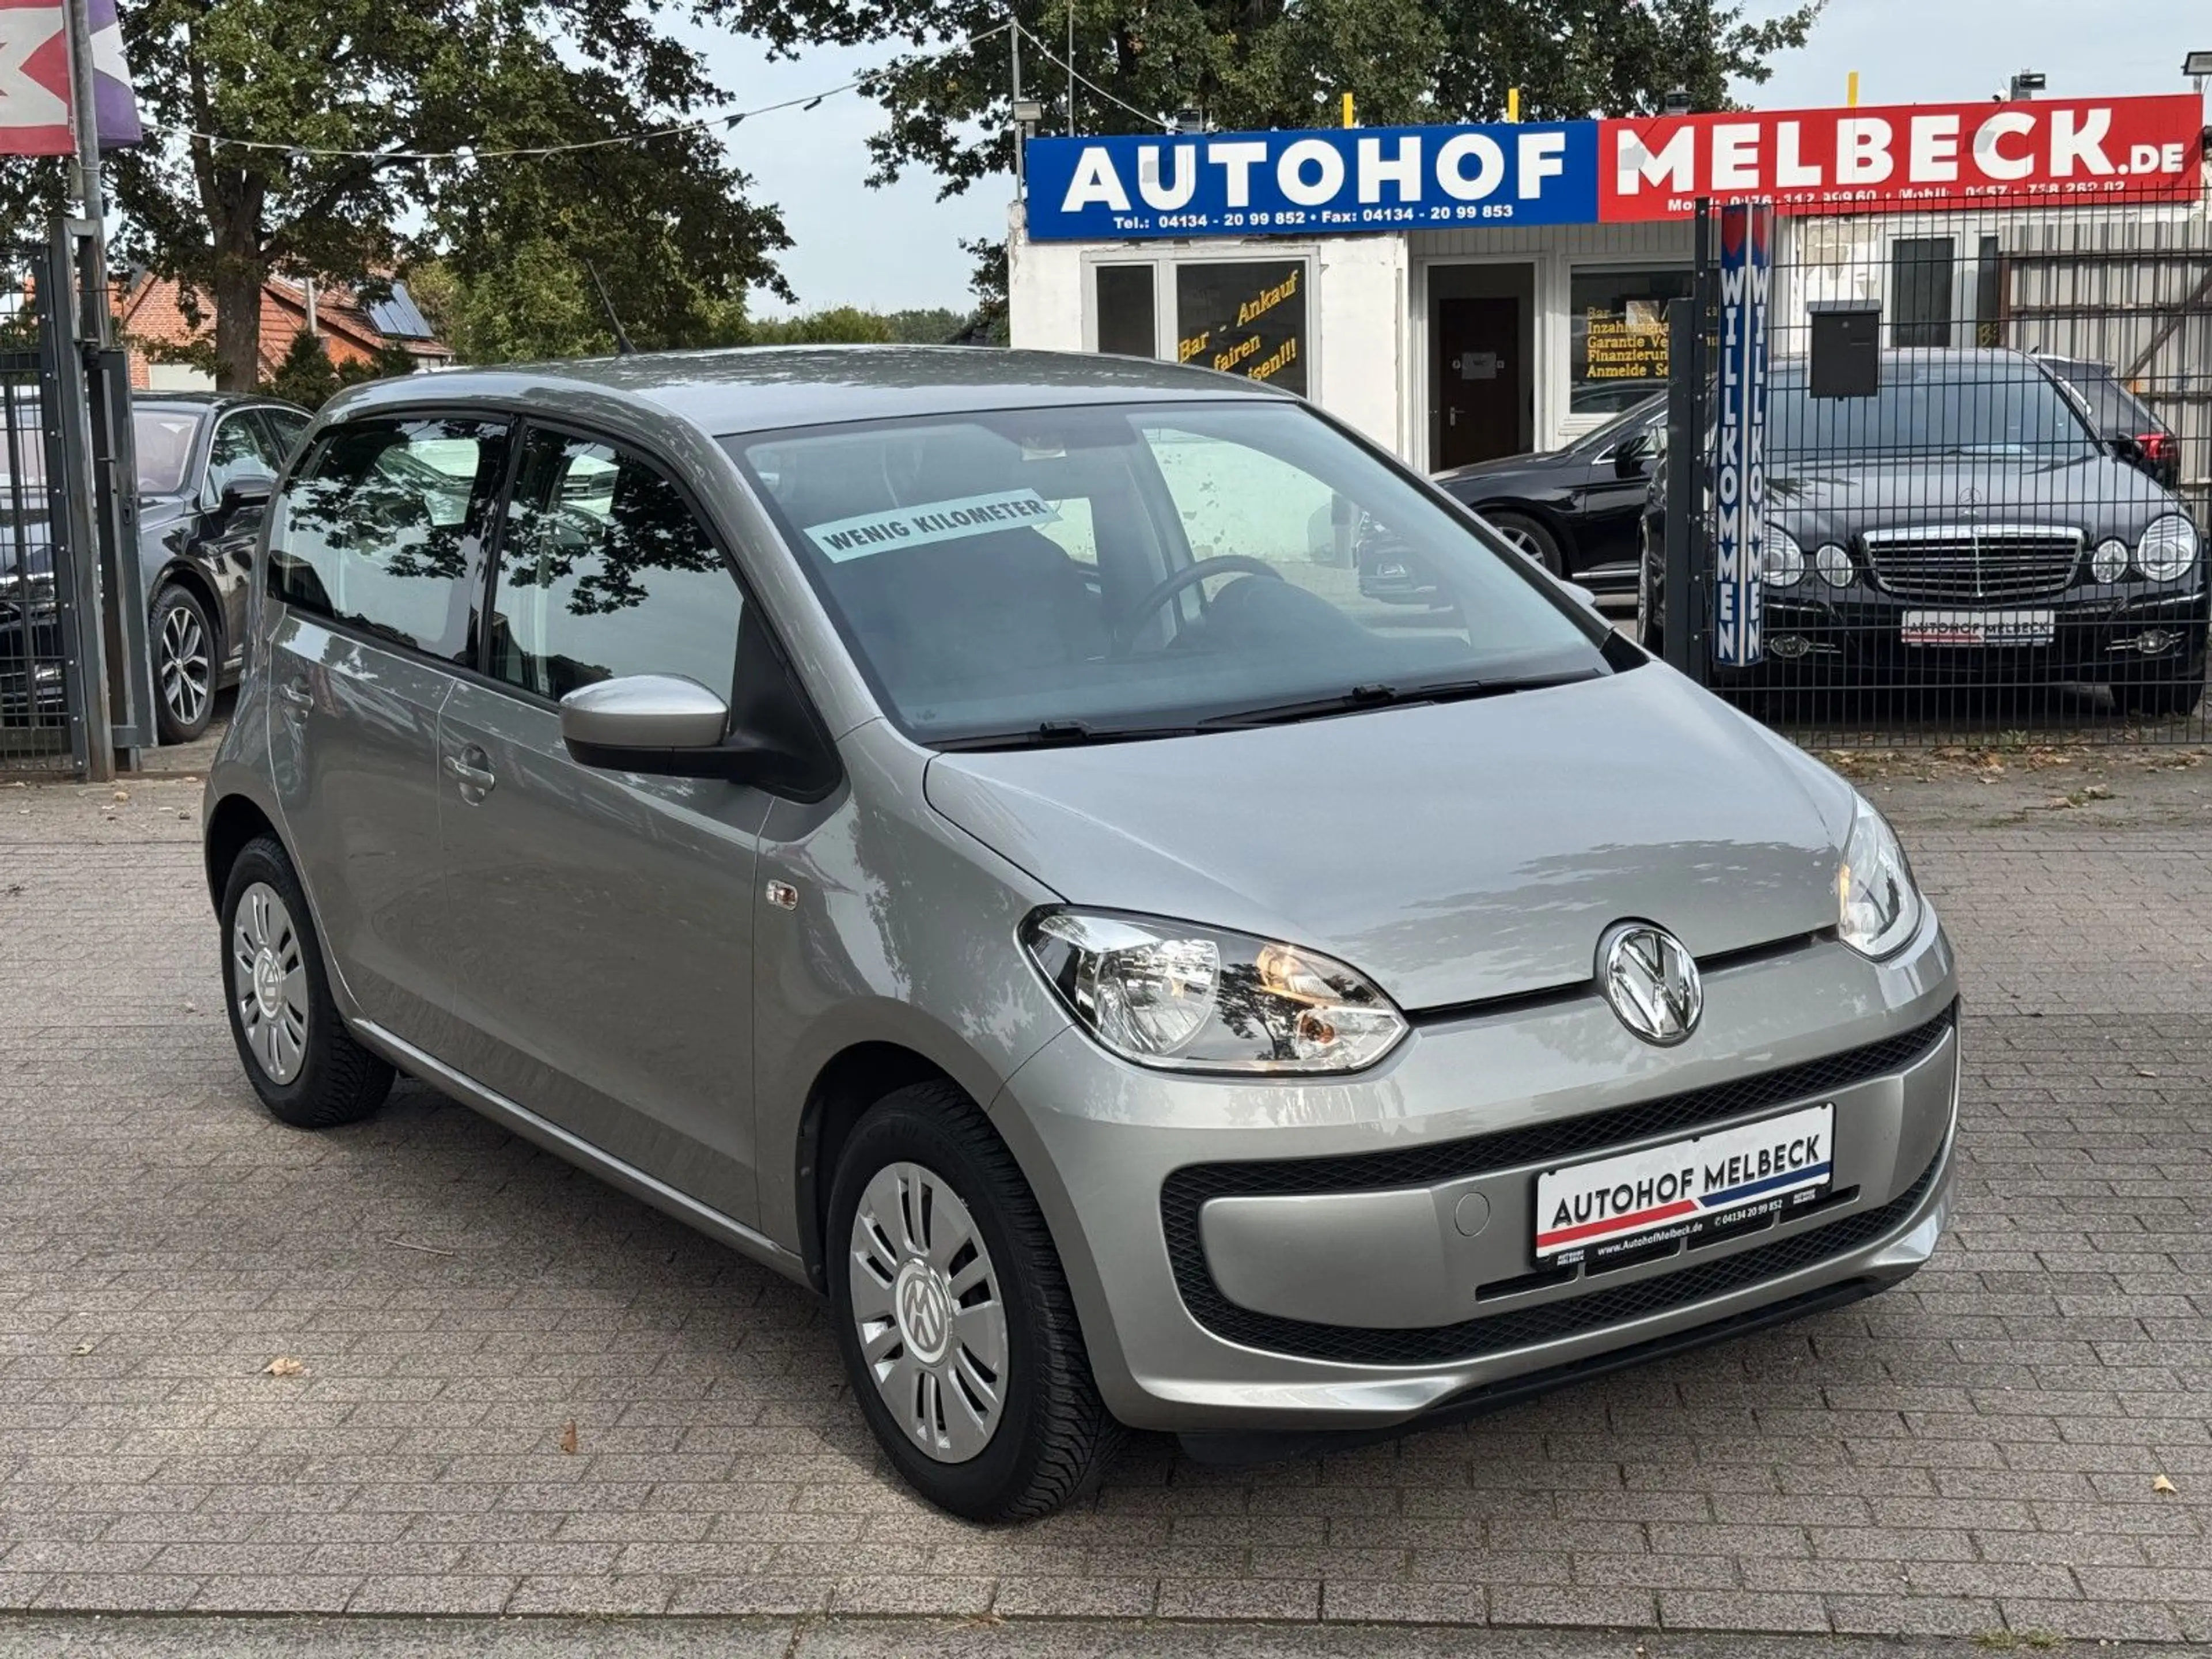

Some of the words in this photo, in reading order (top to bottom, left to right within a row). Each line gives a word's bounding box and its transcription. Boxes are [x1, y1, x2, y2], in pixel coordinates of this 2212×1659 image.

[1061, 132, 1566, 213] AUTOHOF
[1113, 216, 1150, 229] Tel.:
[1158, 214, 1208, 228] 04134
[1224, 214, 1244, 226] 20
[1249, 213, 1270, 225] 99
[1275, 212, 1305, 225] 852
[1321, 210, 1357, 224] Fax:
[1362, 208, 1414, 222] 04134
[1430, 206, 1451, 220] 20
[1456, 206, 1477, 219] 99
[1482, 204, 1513, 218] 853
[1179, 331, 1210, 364] Bar
[1237, 270, 1298, 328] Ankauf
[1214, 333, 1261, 372] fairen
[1247, 338, 1297, 382] isen!!!
[1588, 336, 1645, 348] Garantie
[1586, 363, 1647, 378] Anmelde
[1719, 268, 1745, 661] WILLKOMMEN
[1747, 266, 1770, 660] WILLKOMMEN
[822, 520, 910, 551] WENIG
[911, 498, 1047, 533] KILOMETER
[1552, 1168, 1694, 1229] AUTOHOF
[1703, 1134, 1820, 1193] MELBECK
[1597, 1221, 1703, 1257] www.AutohofMelbeck.de
